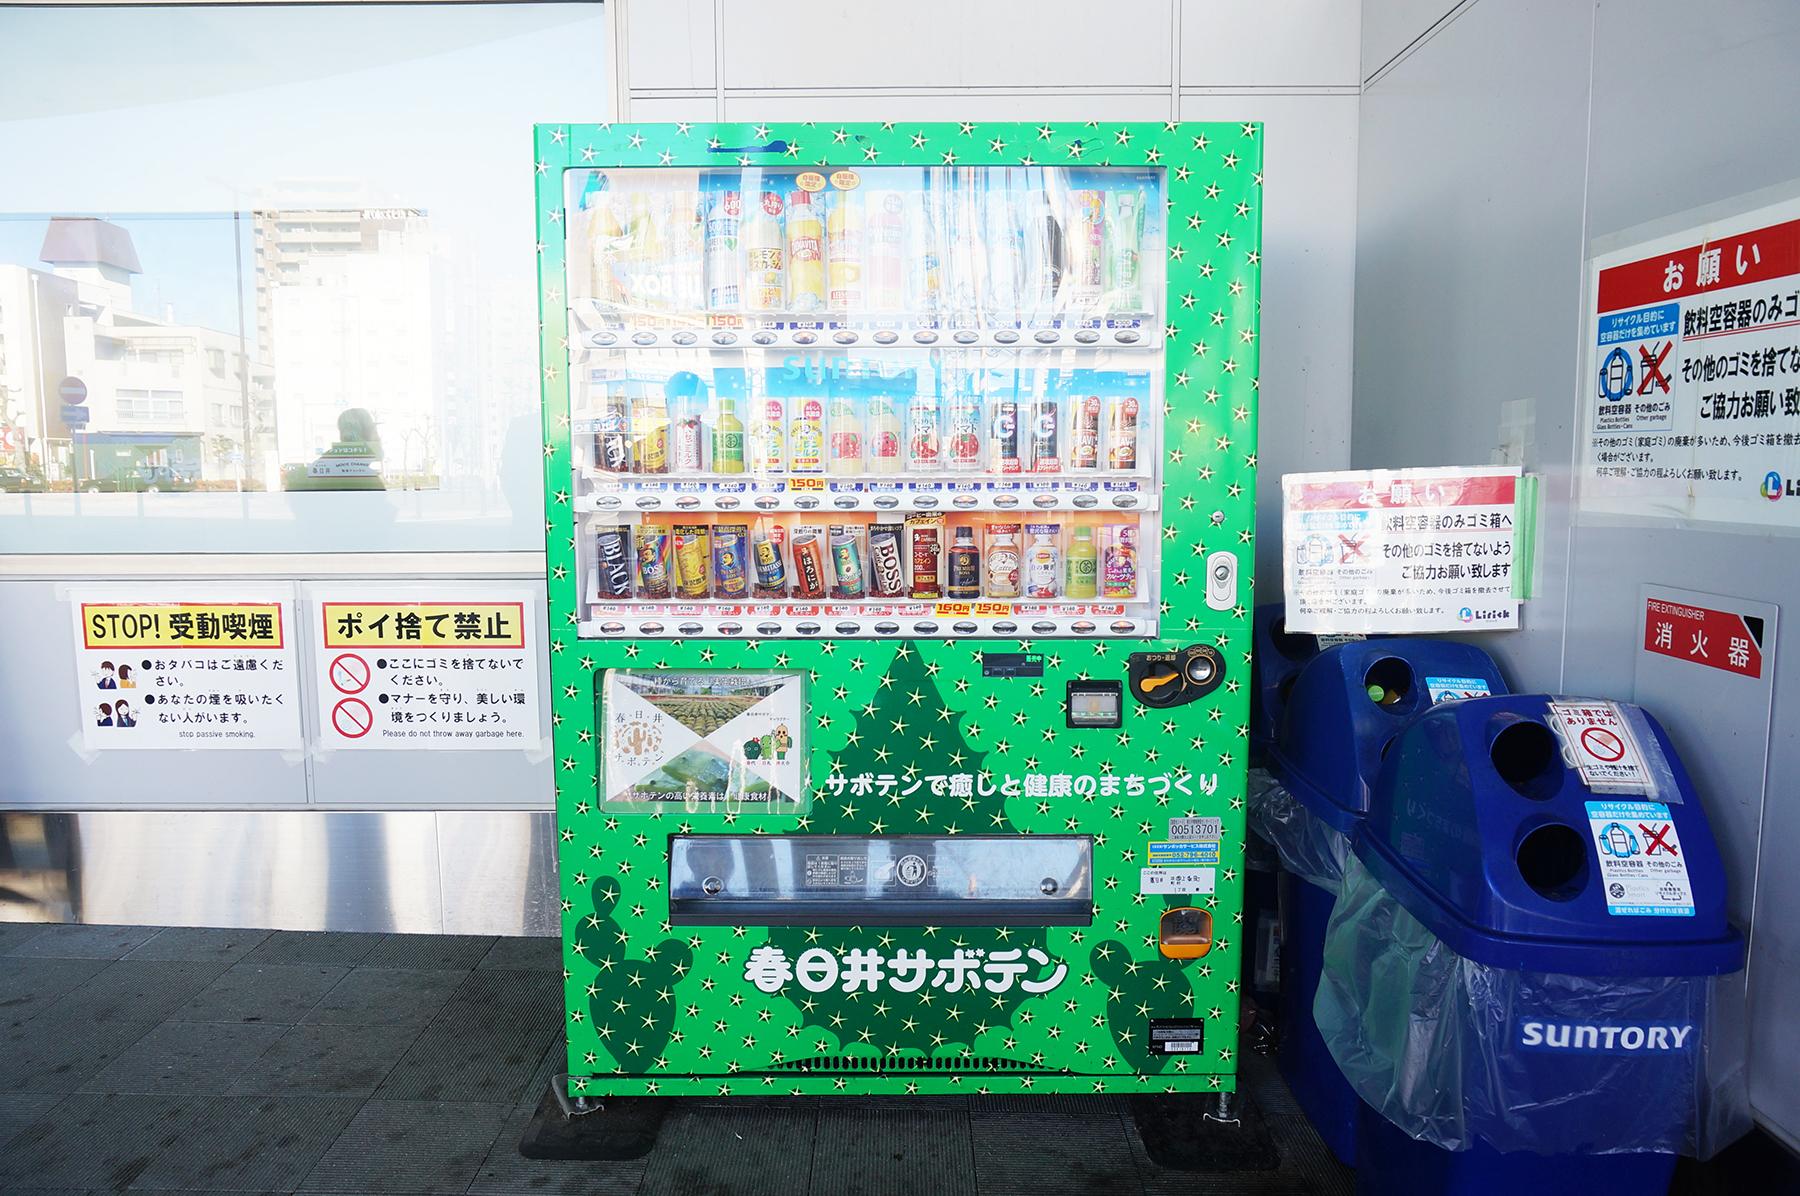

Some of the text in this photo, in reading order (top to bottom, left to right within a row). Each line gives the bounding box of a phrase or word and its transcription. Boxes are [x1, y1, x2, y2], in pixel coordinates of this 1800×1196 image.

[1663, 243, 1761, 293] お願い
[1612, 310, 1665, 327] リサイクル目的に
[1600, 321, 1677, 343] 空容器だけを集めています
[1598, 402, 1671, 416] 飲料空容器 その他のごみ
[790, 478, 824, 488] 150円
[1359, 484, 1445, 504] お願い
[1383, 541, 1511, 558] その他のゴミを捨てないよう
[603, 541, 630, 595] BLACK
[880, 543, 902, 593] BOSS
[1402, 563, 1511, 580] ご協力お願い致します
[938, 603, 970, 612] 160円
[976, 603, 1010, 612] 150円
[1648, 600, 1705, 621] FIRE EXTINGUISHER
[1475, 609, 1510, 620] Lirick
[92, 612, 274, 640] STOP! 受動喫煙
[337, 611, 512, 640] ポイ捨て禁止
[1654, 621, 1750, 668] 消火器
[154, 658, 283, 671] おタバコはご遠慮くだ
[389, 657, 524, 670] ここにゴミを捨てないで
[155, 676, 184, 687] さい。
[390, 674, 444, 687] ください。
[157, 693, 284, 706] あなたの煙を吸いたく
[391, 693, 526, 706] マナーを守り、美しい環
[158, 711, 249, 725] ない人がいます。
[391, 711, 508, 724] 境をつくりましょう。
[1567, 717, 1617, 726] ありません
[196, 730, 223, 739] passive
[225, 730, 255, 739] smoking.
[382, 729, 525, 739] Please do not throw away garbage here.
[825, 772, 1219, 798] サボテンで癒しと健康のまちづくり
[1600, 803, 1656, 811] リサイクル目的に
[1171, 825, 1218, 834] 00513701
[1606, 860, 1683, 868] 飲料空容器 その他のごみ
[745, 946, 1068, 994] 春日井サボテン
[1522, 1022, 1693, 1051] SUNTORY
